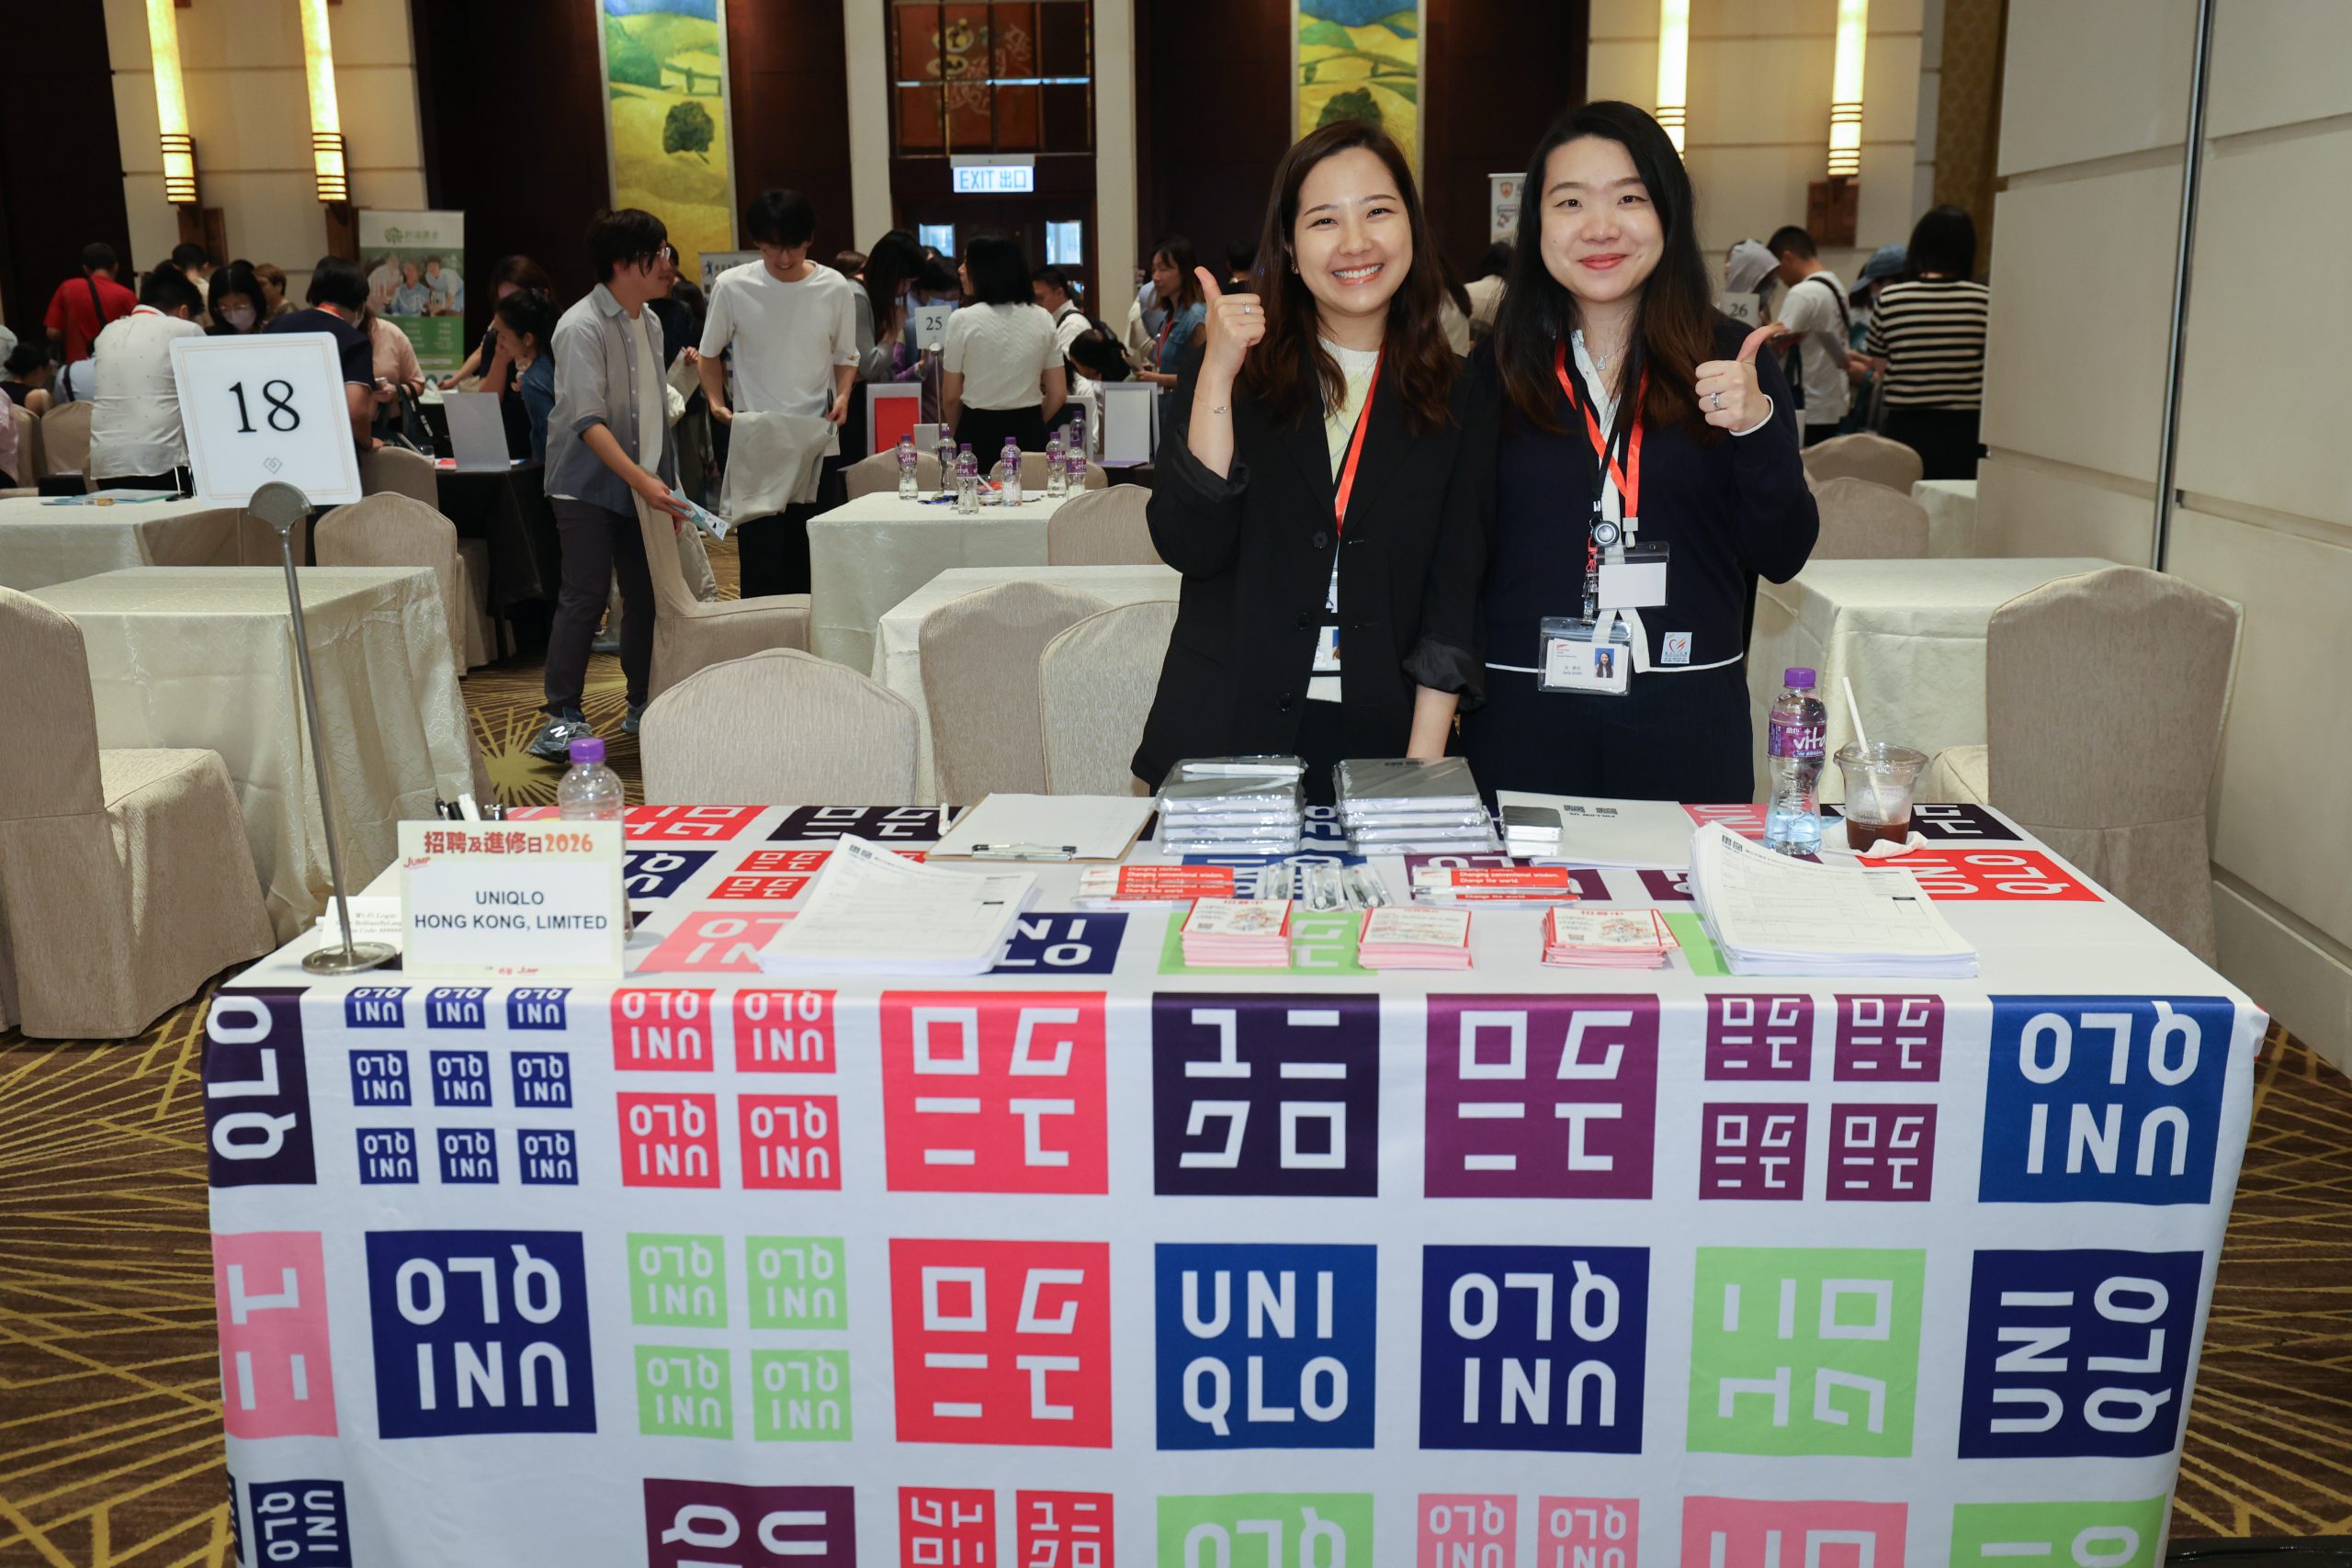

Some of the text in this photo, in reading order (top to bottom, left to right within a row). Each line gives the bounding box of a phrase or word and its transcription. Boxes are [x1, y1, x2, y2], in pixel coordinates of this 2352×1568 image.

[959, 170, 1027, 189] EXIT 出口
[926, 316, 943, 331] 25
[1729, 302, 1748, 318] 26
[229, 379, 300, 433] 18
[424, 831, 594, 854] 招聘及進修日2026
[1885, 858, 1979, 895] UNI
[1963, 854, 2071, 895] QLO
[476, 891, 545, 905] UNIQLO
[415, 915, 607, 931] HONG KONG, LIMITED
[1012, 919, 1081, 940] NI
[1001, 943, 1092, 966] LO
[356, 1001, 397, 1021] UNI
[436, 1002, 478, 1021] UNI
[517, 1003, 560, 1023] UNI
[621, 990, 699, 1019] QLO
[744, 991, 822, 1021] QLO
[631, 1027, 701, 1059] UNI
[753, 1028, 823, 1061] UNI
[1185, 1009, 1346, 1078] ユニ
[2019, 1000, 2201, 1085] QLO
[206, 996, 296, 1159] QLO
[356, 1054, 401, 1076] QLO
[437, 1055, 482, 1077] QLO
[518, 1055, 563, 1078] QLO
[363, 1080, 404, 1099] UNI
[444, 1080, 485, 1100] UNI
[524, 1082, 566, 1101] UNI
[630, 1100, 706, 1137] QLO
[751, 1101, 827, 1139] QLO
[1180, 1100, 1346, 1168] クロ
[364, 1132, 409, 1154] QLO
[445, 1132, 490, 1154] QLO
[525, 1134, 570, 1156] QLO
[2027, 1104, 2188, 1176] UNI
[370, 1158, 412, 1177] UNI
[450, 1158, 492, 1177] UNI
[530, 1159, 571, 1179] UNI
[639, 1144, 707, 1176] UNI
[760, 1145, 829, 1178] UNI
[639, 1241, 714, 1278] QLO
[758, 1243, 834, 1280] QLO
[396, 1245, 561, 1325] QLO
[649, 1283, 716, 1316] UNI
[767, 1286, 835, 1317] UNI
[1450, 1261, 1619, 1341] QLO
[1182, 1271, 1333, 1338] UNI
[1991, 1292, 2074, 1433] UNI
[2084, 1277, 2171, 1432] QLO
[417, 1342, 569, 1409] UNI
[647, 1354, 719, 1390] QLO
[763, 1356, 838, 1392] QLO
[1183, 1356, 1348, 1435] QLO
[1464, 1358, 1616, 1426] UNI
[656, 1394, 721, 1427] UNI
[772, 1399, 840, 1429] UNI
[257, 1493, 300, 1561] QLO
[304, 1491, 338, 1551] UNI
[1430, 1500, 1505, 1536] QLO
[1551, 1505, 1627, 1540] QLO
